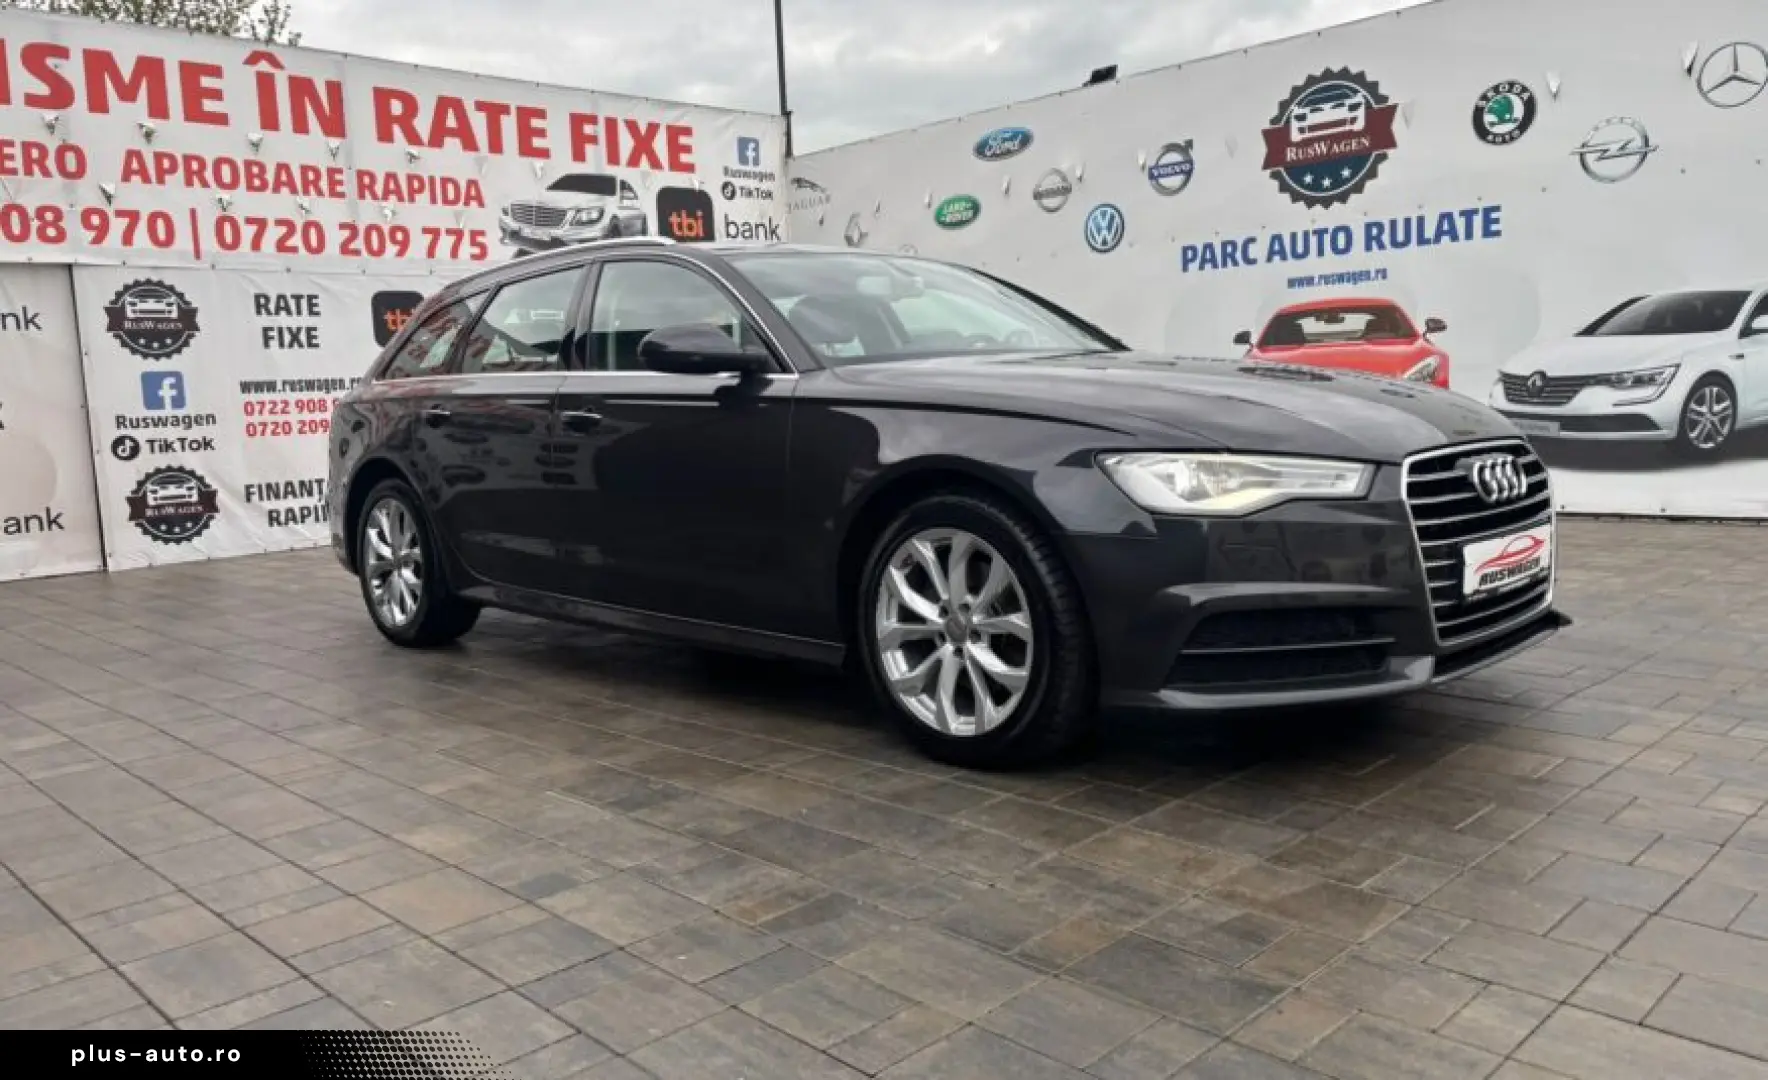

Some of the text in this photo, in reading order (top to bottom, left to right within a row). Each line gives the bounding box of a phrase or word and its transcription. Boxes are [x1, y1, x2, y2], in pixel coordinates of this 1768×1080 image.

[243, 50, 346, 139] ÎN
[372, 86, 551, 159] RATE
[569, 112, 696, 174] FIXE
[0, 139, 486, 208] ERO APROBARE RAPIDA
[1151, 162, 1191, 178] VOLVO
[739, 186, 773, 200] TikTok
[0, 203, 67, 244] 08
[81, 208, 175, 248] 970
[214, 214, 325, 255] 0720
[338, 222, 411, 258] 209
[422, 226, 488, 261] 775
[667, 209, 705, 237] tbi
[724, 213, 781, 241] bank
[1181, 204, 1503, 273] PARC AUTO RULATE
[254, 293, 321, 317] RATE
[262, 325, 320, 349] FIXE
[243, 400, 291, 416] 0722
[295, 398, 328, 414] 908
[115, 414, 216, 430] Ruswagen
[246, 419, 329, 437] 0720 209
[145, 436, 216, 454] TikTok
